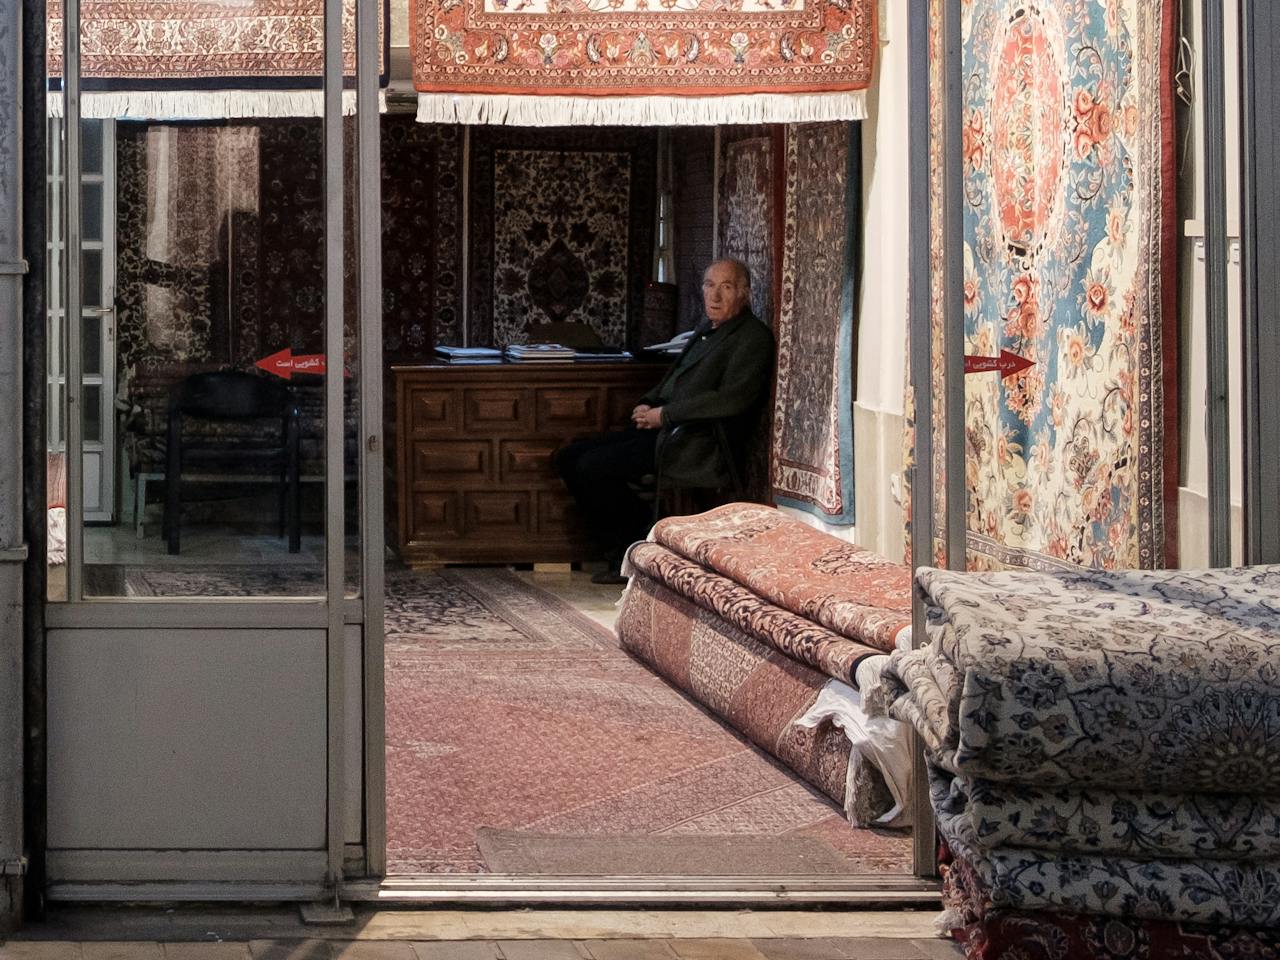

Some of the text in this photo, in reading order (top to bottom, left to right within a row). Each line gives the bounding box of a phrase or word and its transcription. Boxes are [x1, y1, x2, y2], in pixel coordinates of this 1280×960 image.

[275, 359, 293, 368] است
[294, 358, 320, 369] کشویی
[972, 359, 997, 370] کشویی
[999, 360, 1016, 369] درب
